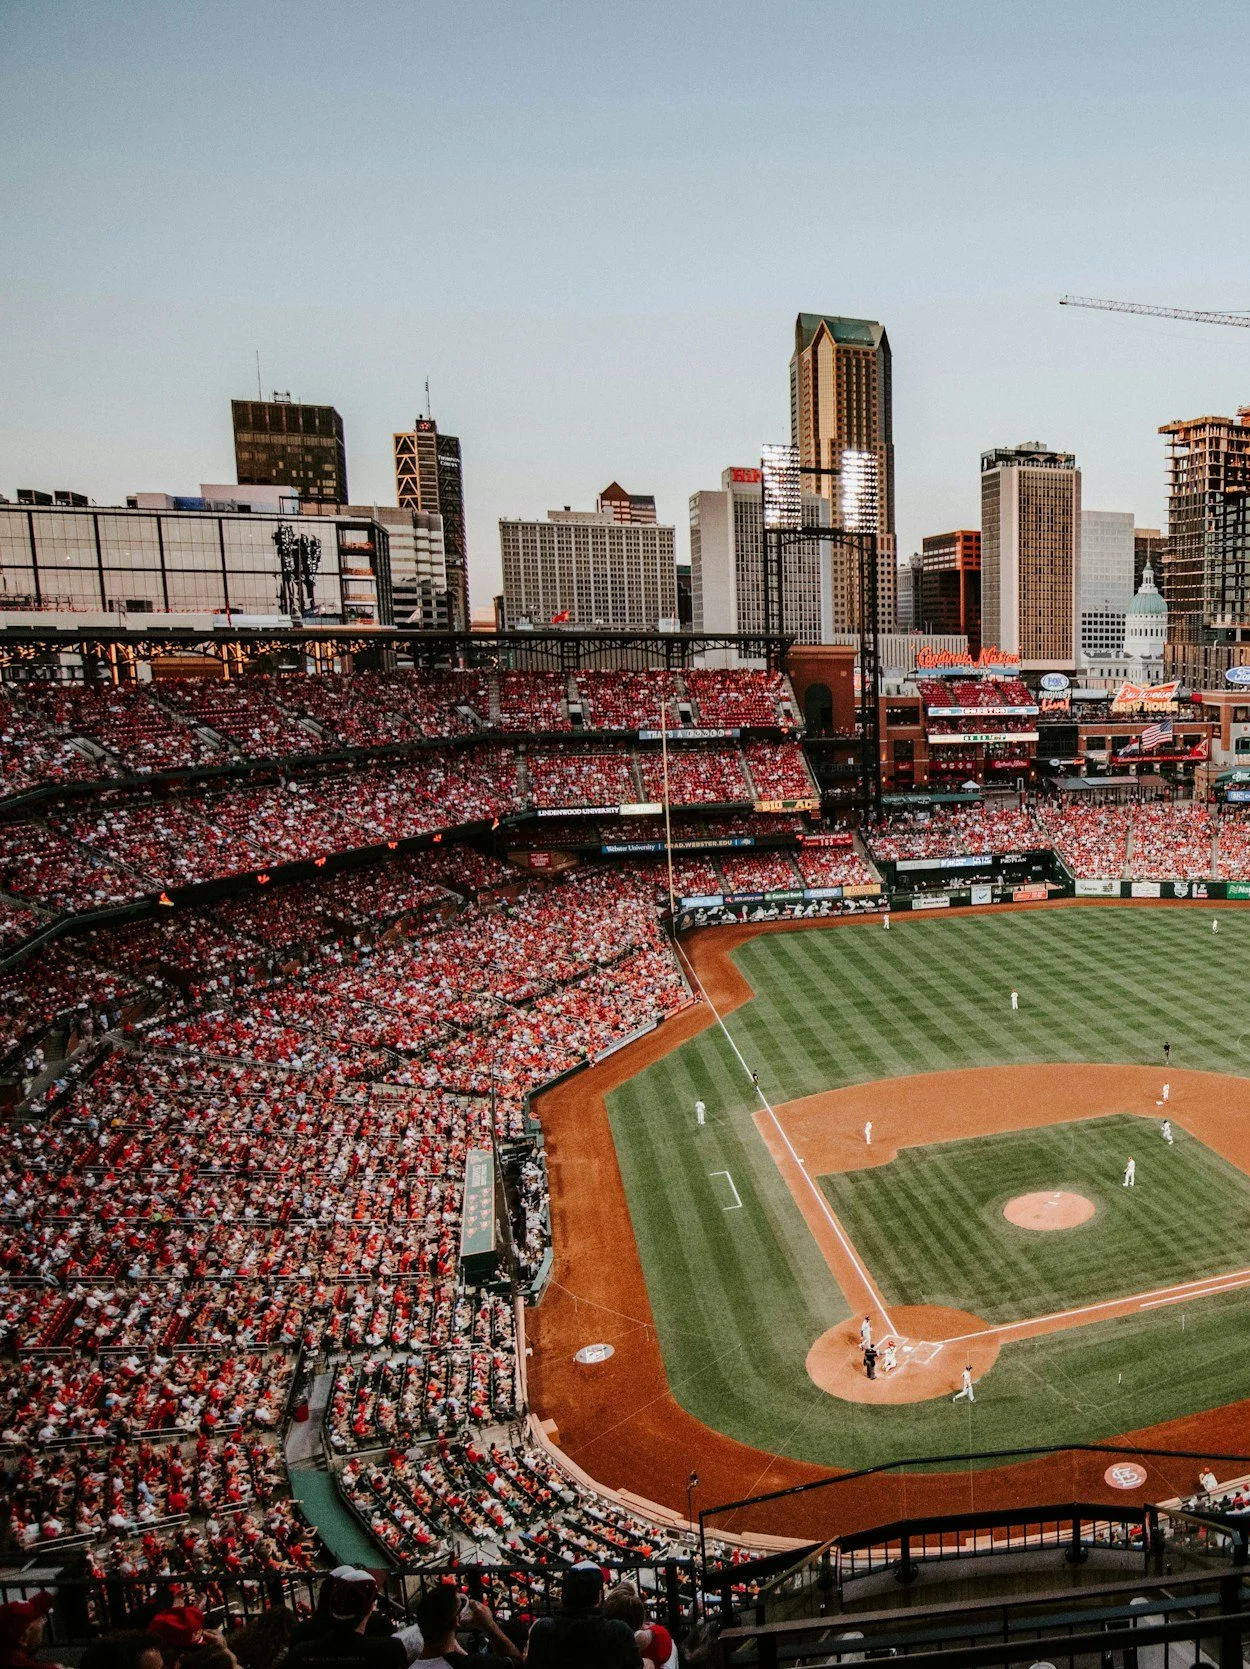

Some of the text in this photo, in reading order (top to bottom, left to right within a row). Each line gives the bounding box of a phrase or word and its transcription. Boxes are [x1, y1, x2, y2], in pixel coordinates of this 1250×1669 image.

[917, 646, 1020, 668] Cardinals Nation
[1038, 688, 1072, 700] MIDWEST
[1118, 687, 1178, 701] Budweiser
[1112, 701, 1179, 712] BREW HOUSE
[538, 808, 582, 817] LINDENWOOD
[582, 806, 619, 815] UNIVERSITY
[606, 845, 628, 853] Webster
[628, 843, 656, 852] University
